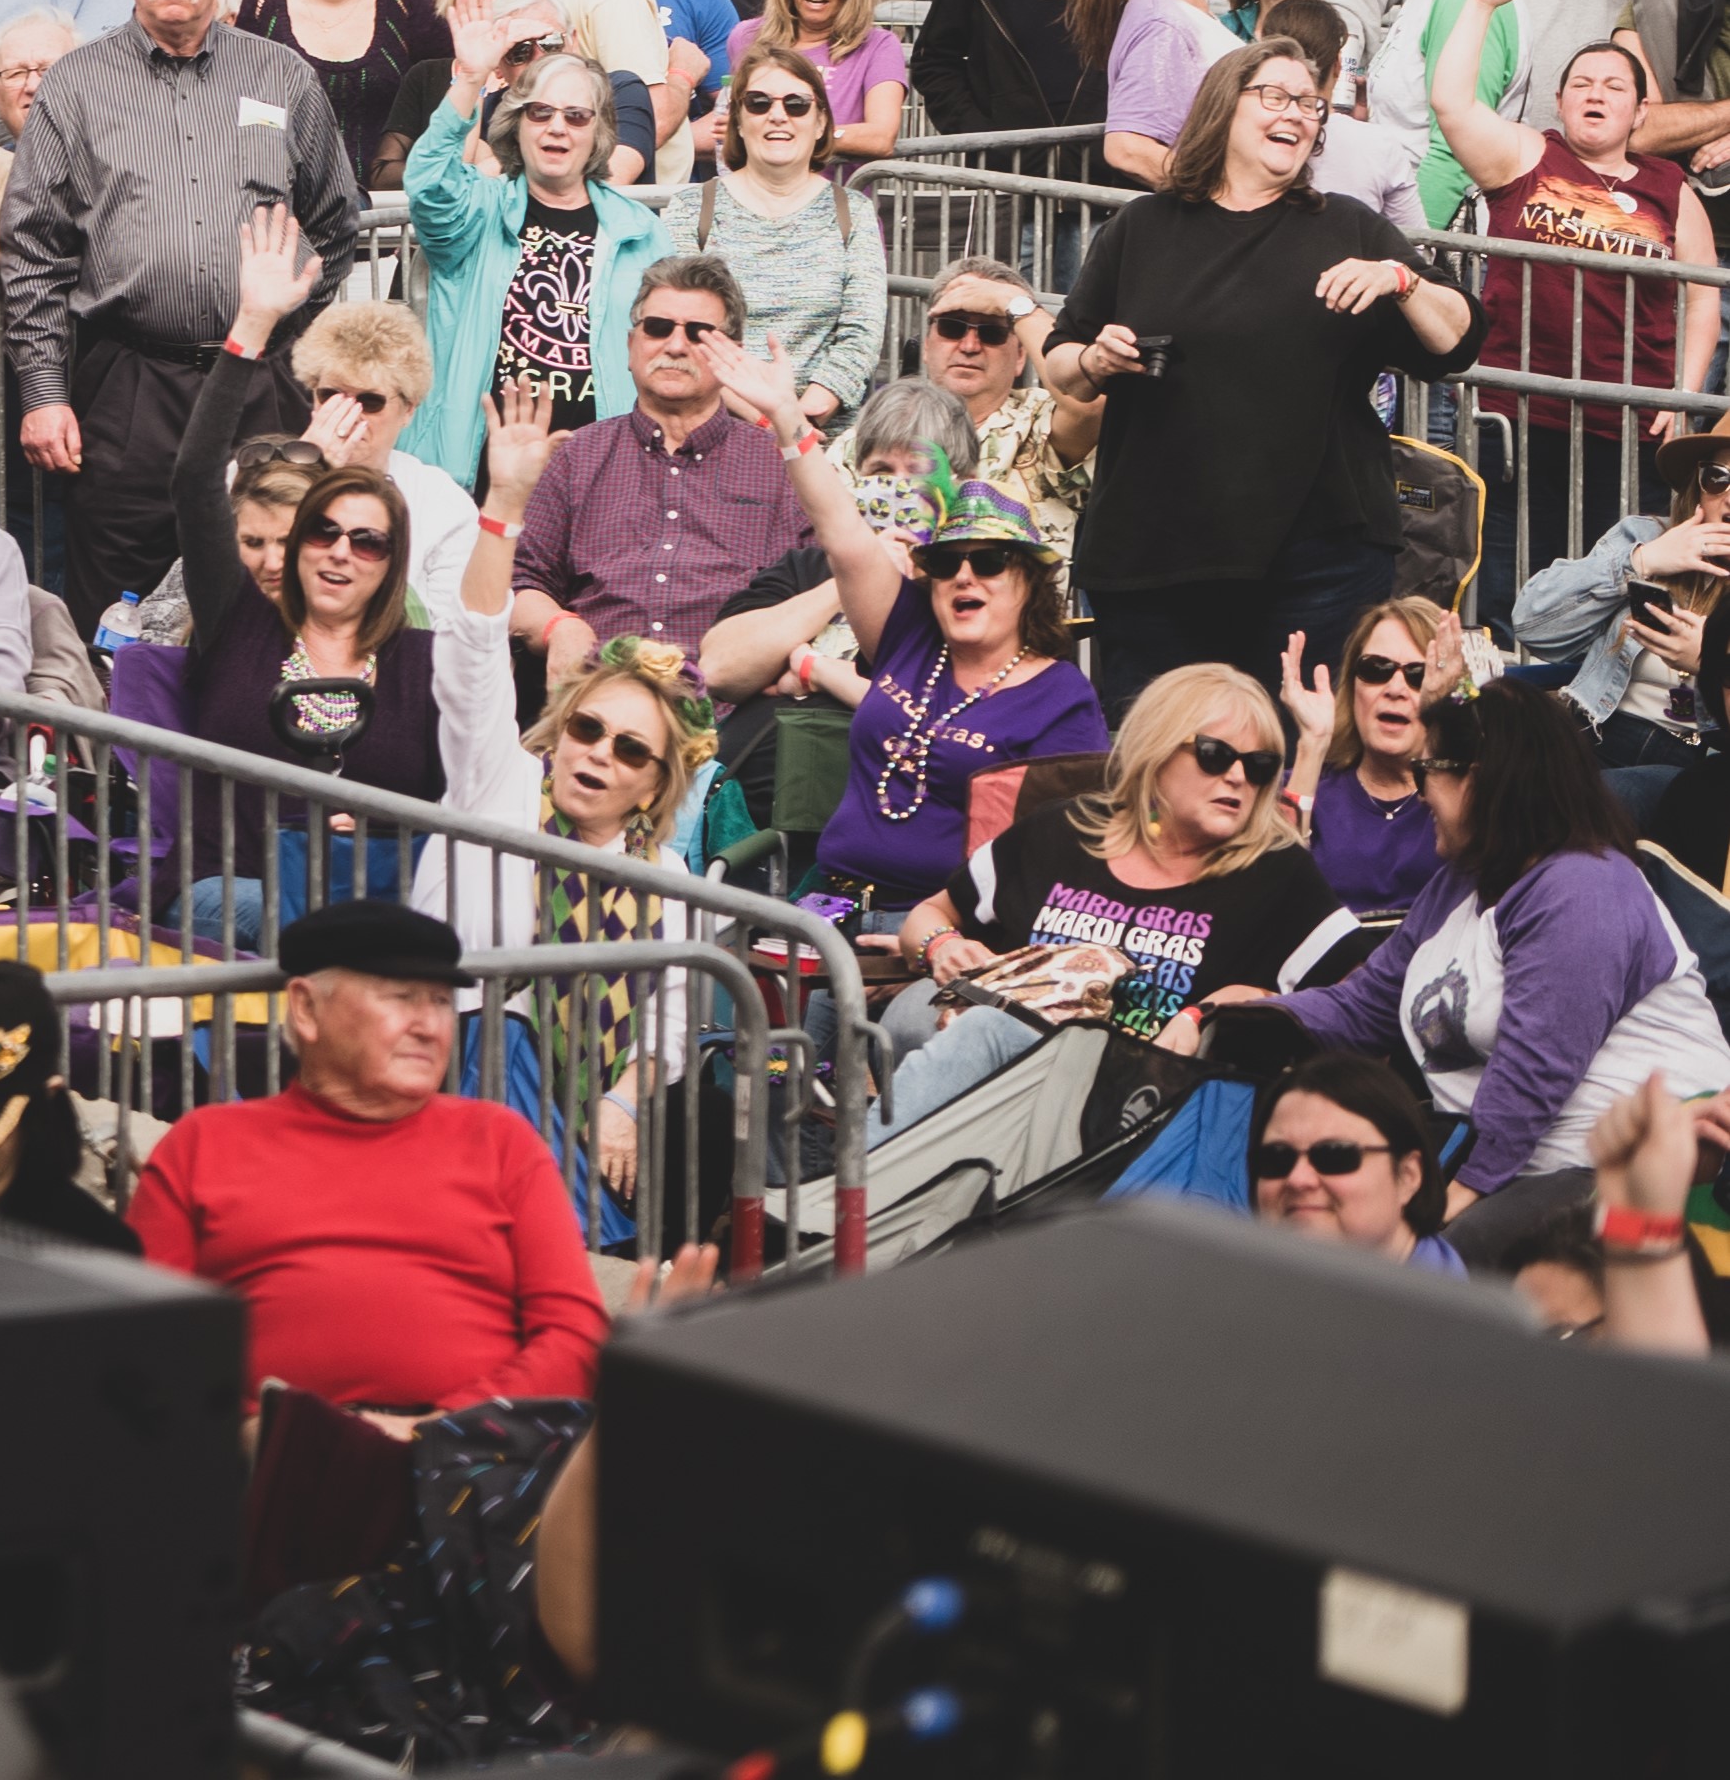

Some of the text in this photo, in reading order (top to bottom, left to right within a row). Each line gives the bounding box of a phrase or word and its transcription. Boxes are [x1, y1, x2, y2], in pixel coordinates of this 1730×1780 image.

[521, 329, 589, 366] MAR
[517, 368, 595, 402] GRA
[1045, 882, 1213, 939] MARDI GRAS
[1032, 905, 1206, 967] MARDI GRAS
